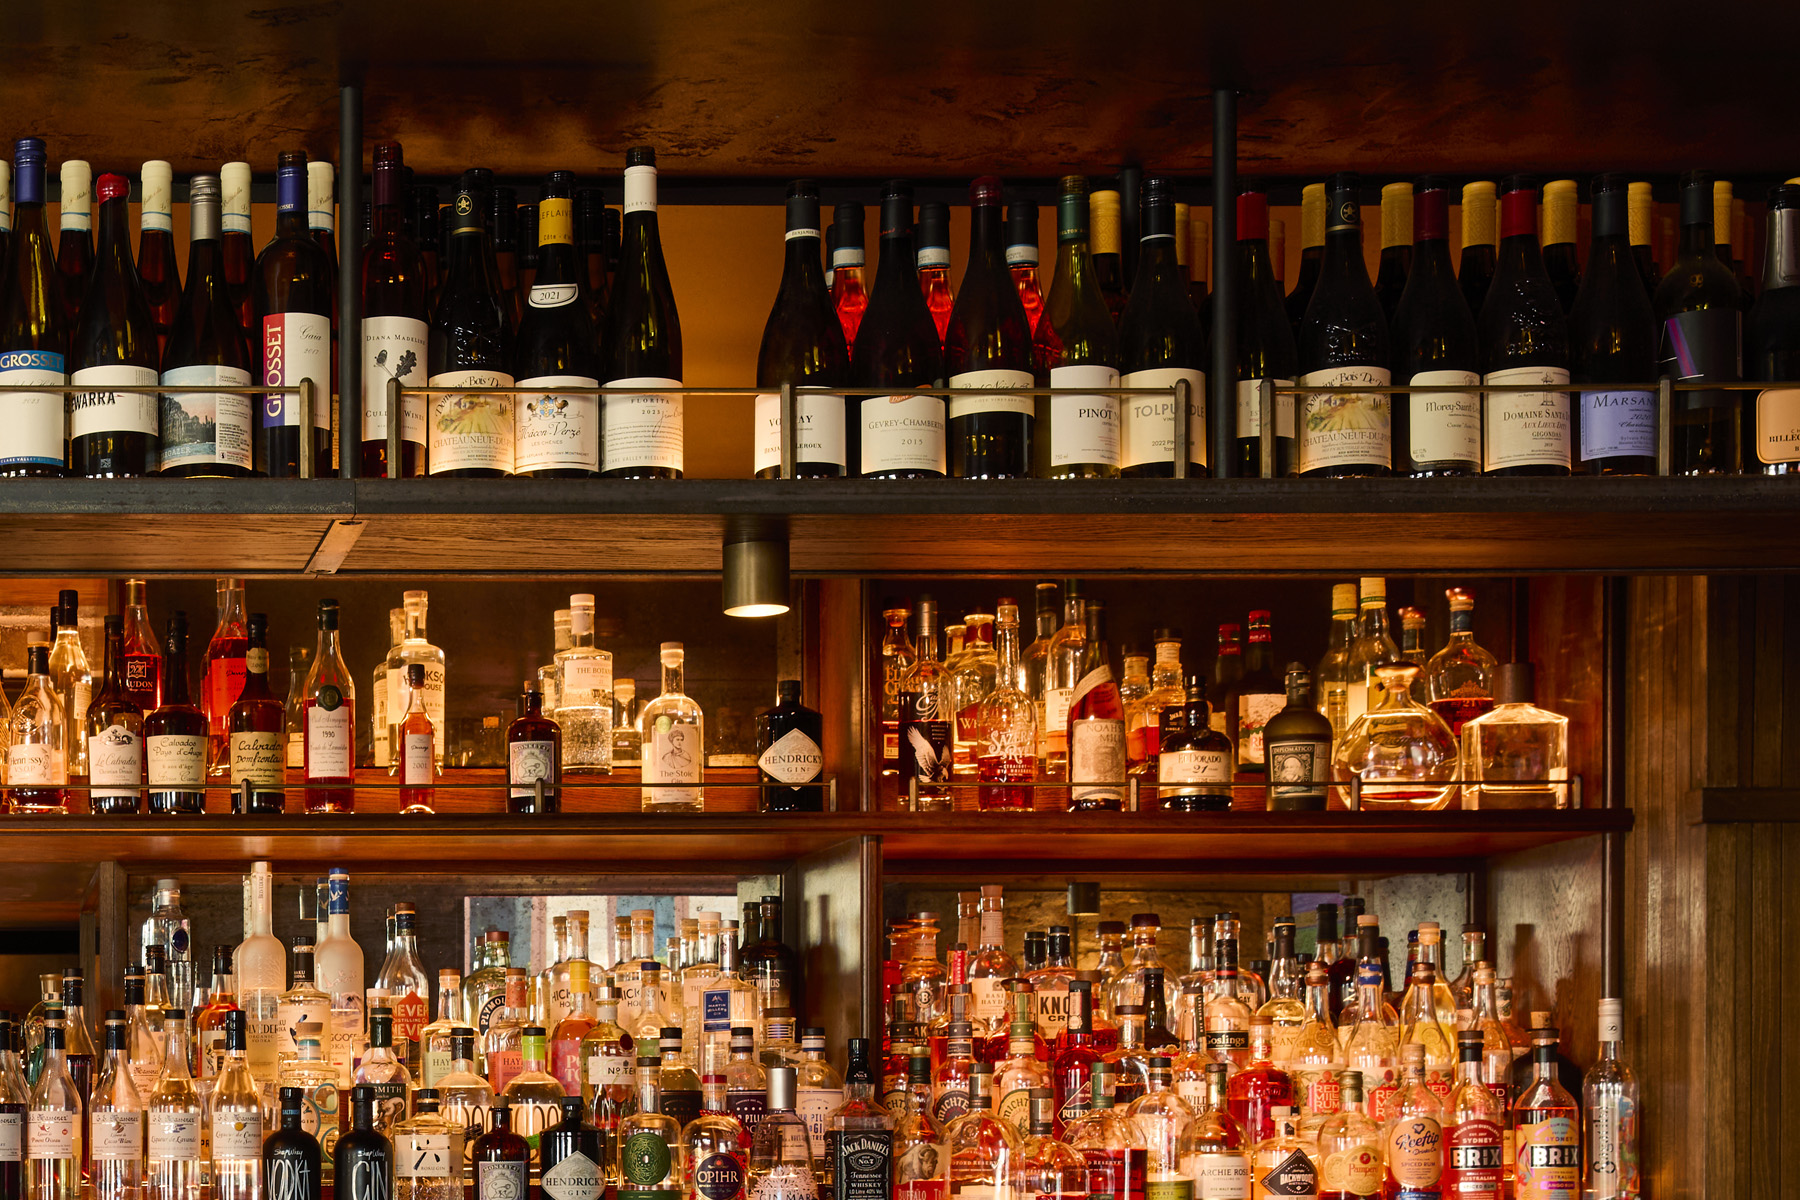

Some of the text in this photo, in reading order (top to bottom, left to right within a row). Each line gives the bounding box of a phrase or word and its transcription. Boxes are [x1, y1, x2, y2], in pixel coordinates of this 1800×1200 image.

[539, 291, 560, 301] 2021
[0, 352, 62, 368] GROSSET
[1079, 408, 1113, 418] PINOT
[1503, 411, 1543, 421] DOMAINE
[322, 730, 335, 738] 1990
[160, 737, 197, 748] Calvados
[153, 747, 175, 759] Pays
[1189, 753, 1222, 763] DORADO
[9, 755, 44, 766] Hennessy
[106, 753, 137, 765] Calvados
[764, 754, 822, 765] HENDRICK'S
[393, 1004, 428, 1016] NEVER
[1206, 1033, 1245, 1046] Goslings
[1316, 1085, 1339, 1093] RED
[1396, 1131, 1439, 1149] Reeftip
[842, 1138, 889, 1156] JACK DANIEL'S
[546, 1177, 605, 1188] HENDRICK'S
[698, 1171, 738, 1183] OPIHR
[898, 1189, 926, 1200] BUFFALO
